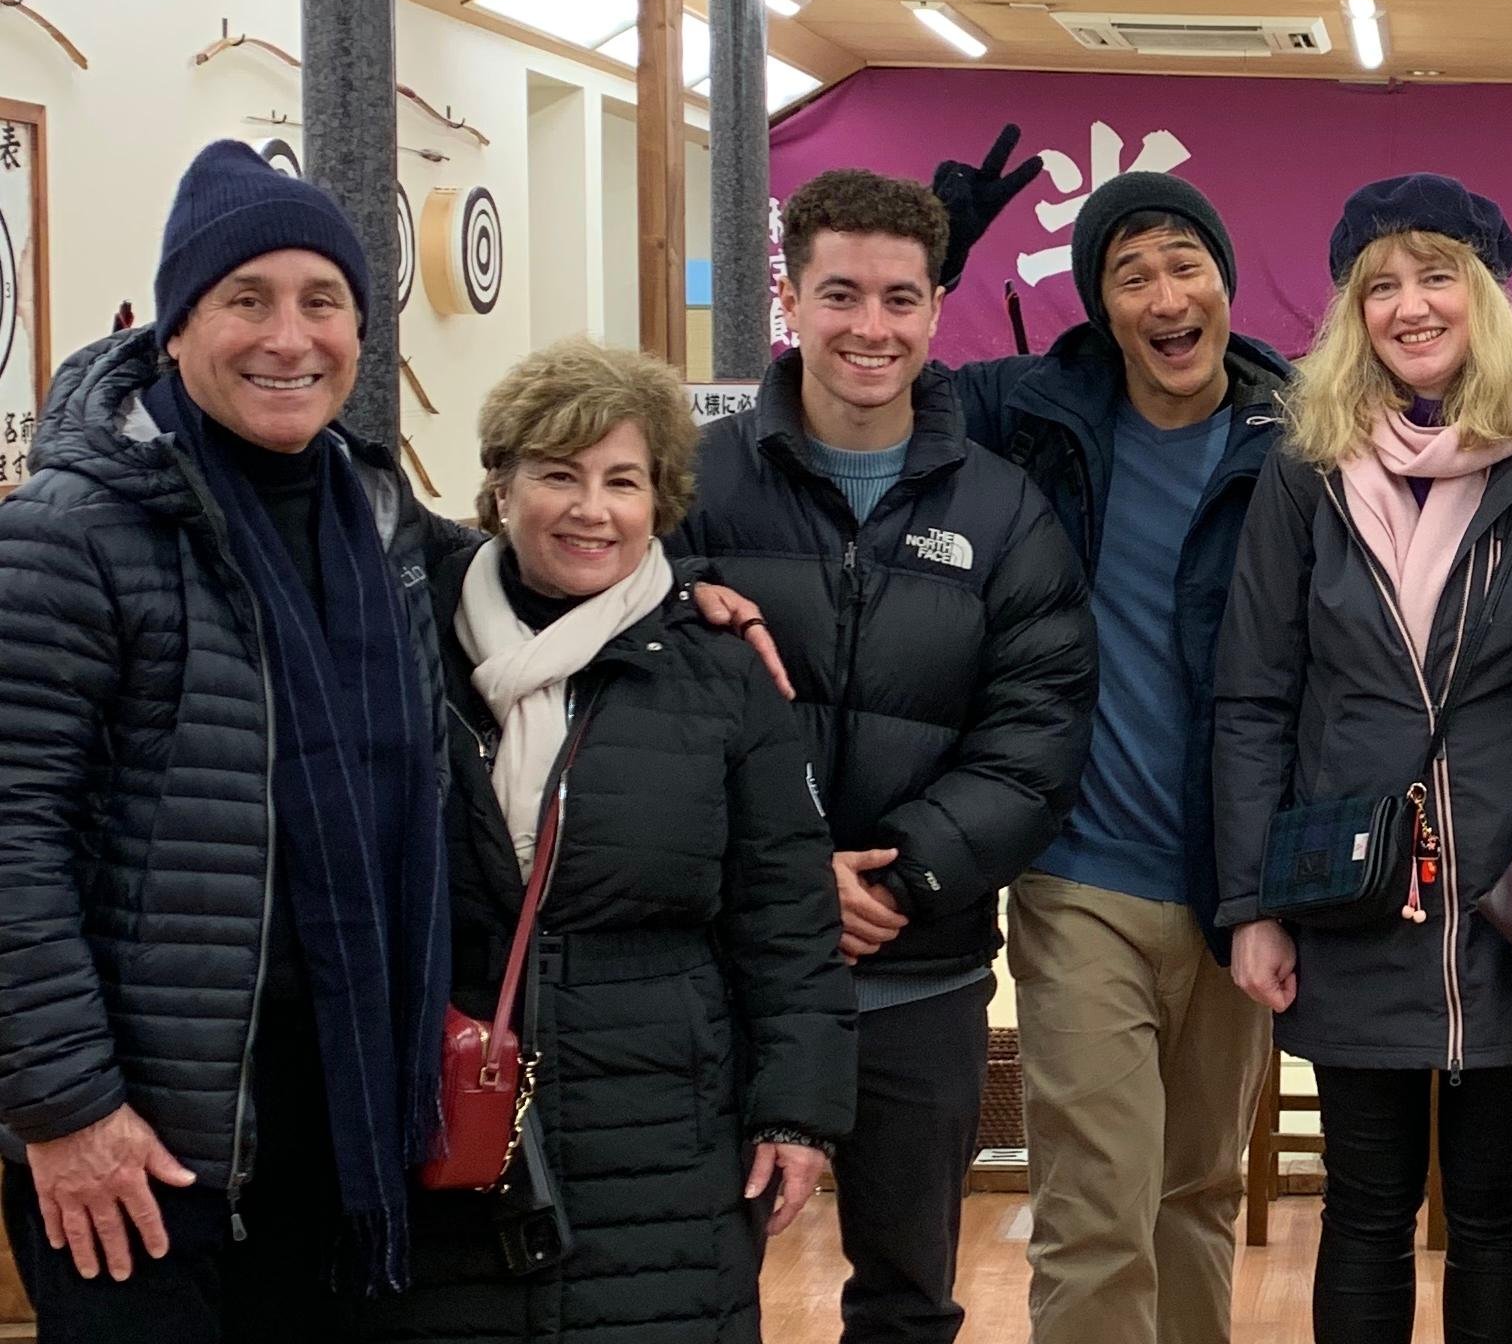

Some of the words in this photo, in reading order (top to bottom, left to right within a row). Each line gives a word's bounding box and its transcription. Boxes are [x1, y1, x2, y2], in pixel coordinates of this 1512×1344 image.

[690, 393, 758, 416] 人様に必
[905, 534, 951, 553] NORTH
[928, 528, 954, 542] THE
[917, 547, 952, 564] FACE
